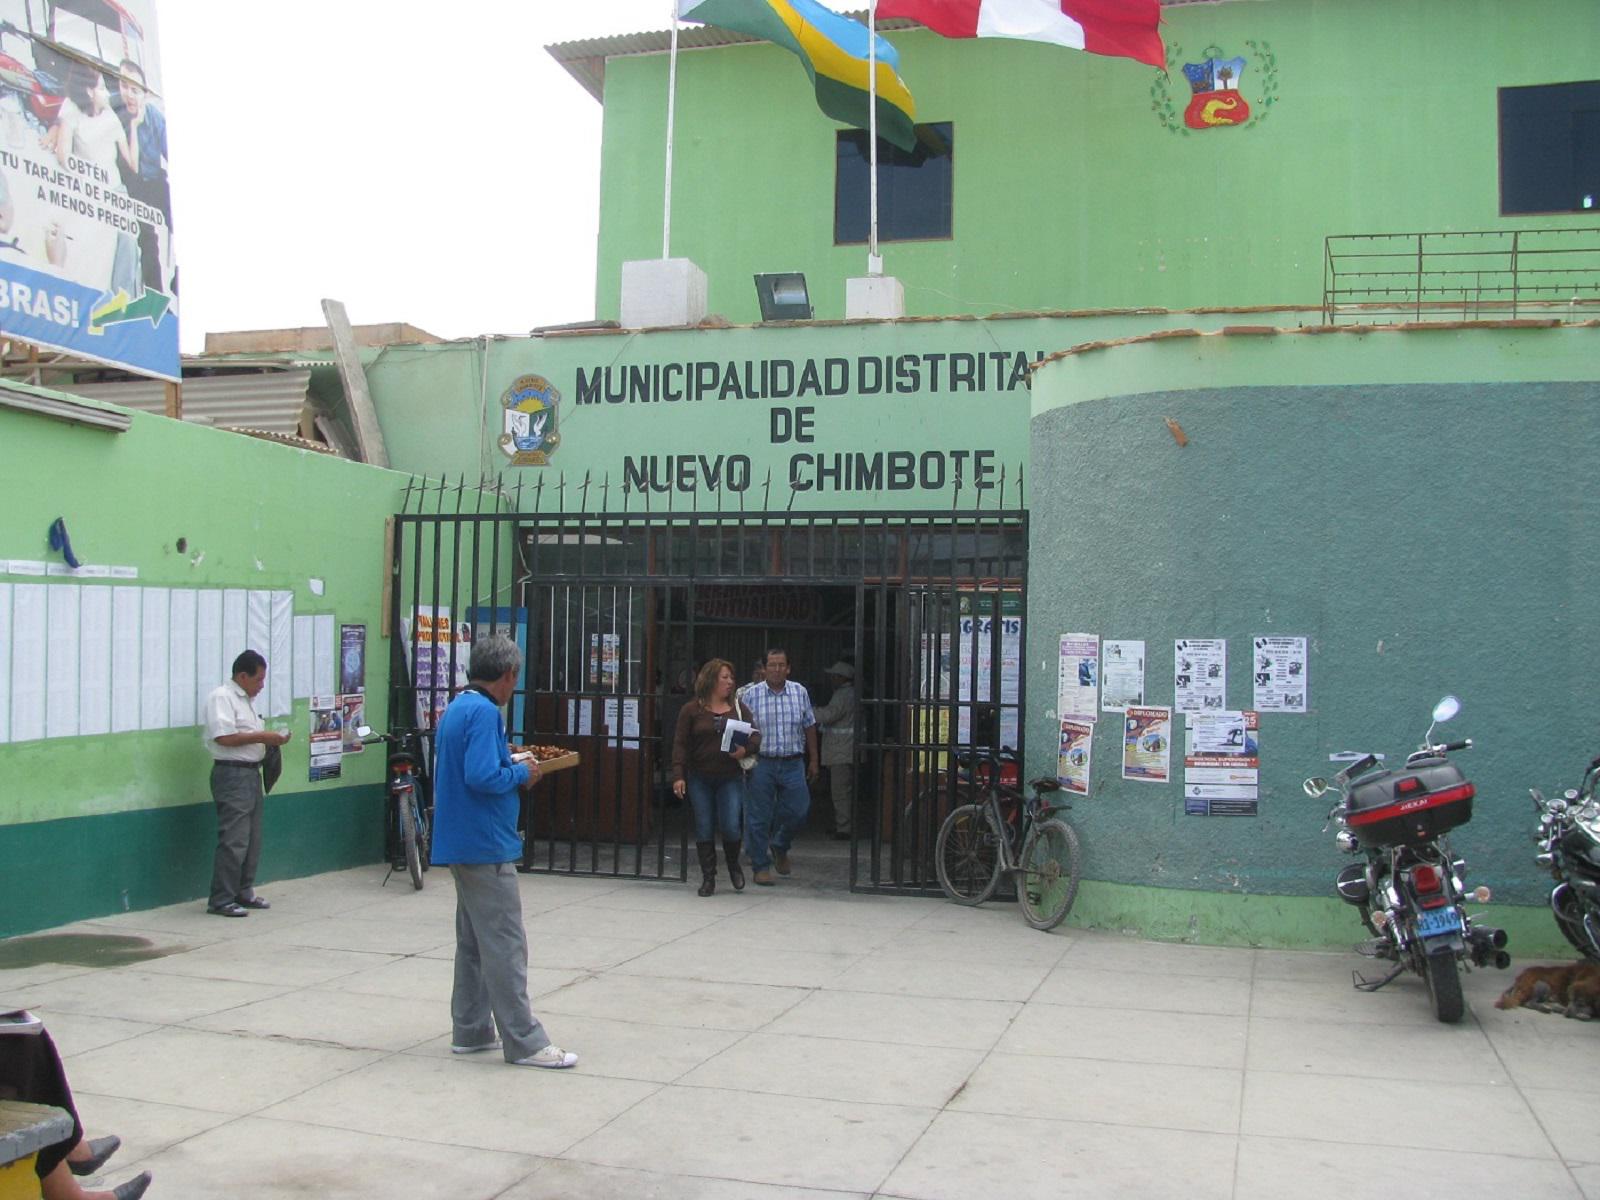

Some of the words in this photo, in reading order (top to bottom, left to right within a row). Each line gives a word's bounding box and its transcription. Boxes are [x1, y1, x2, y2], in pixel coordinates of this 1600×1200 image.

[0, 150, 18, 169] TU
[23, 159, 80, 193] TARJETA
[85, 182, 100, 200] DE
[104, 190, 163, 226] PROPIEDAD
[68, 156, 108, 183] OBTÉN
[37, 185, 46, 200] A
[50, 190, 95, 218] MENOS
[97, 207, 138, 235] PRECIO
[576, 359, 849, 405] MUNICIPALIDAD
[770, 406, 815, 443] DE
[623, 454, 751, 493] NUEVO
[789, 449, 995, 491] CHIMBOTE
